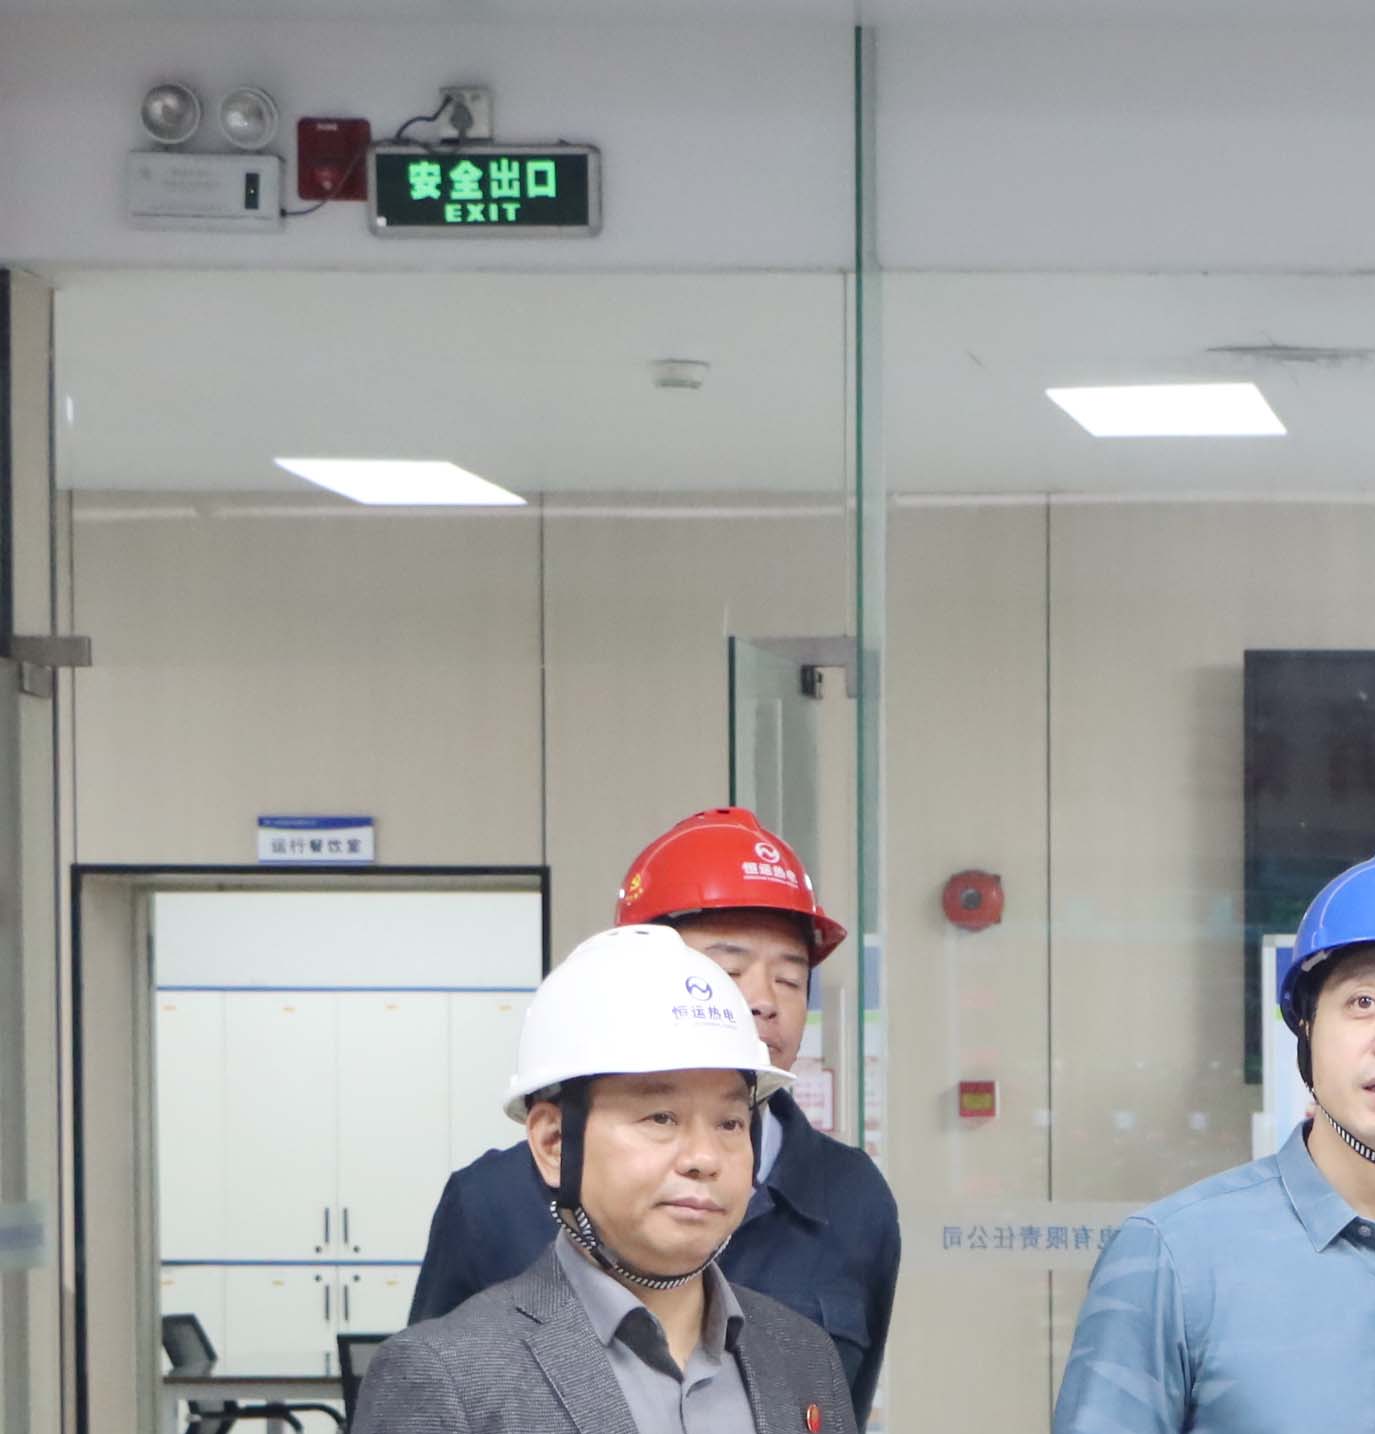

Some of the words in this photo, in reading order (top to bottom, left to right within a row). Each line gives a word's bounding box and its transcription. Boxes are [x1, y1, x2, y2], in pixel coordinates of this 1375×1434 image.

[409, 158, 556, 200] 安全出口
[445, 203, 521, 224] EXIT
[742, 861, 799, 884] 恒运热电
[671, 1004, 736, 1023] 恒运热电
